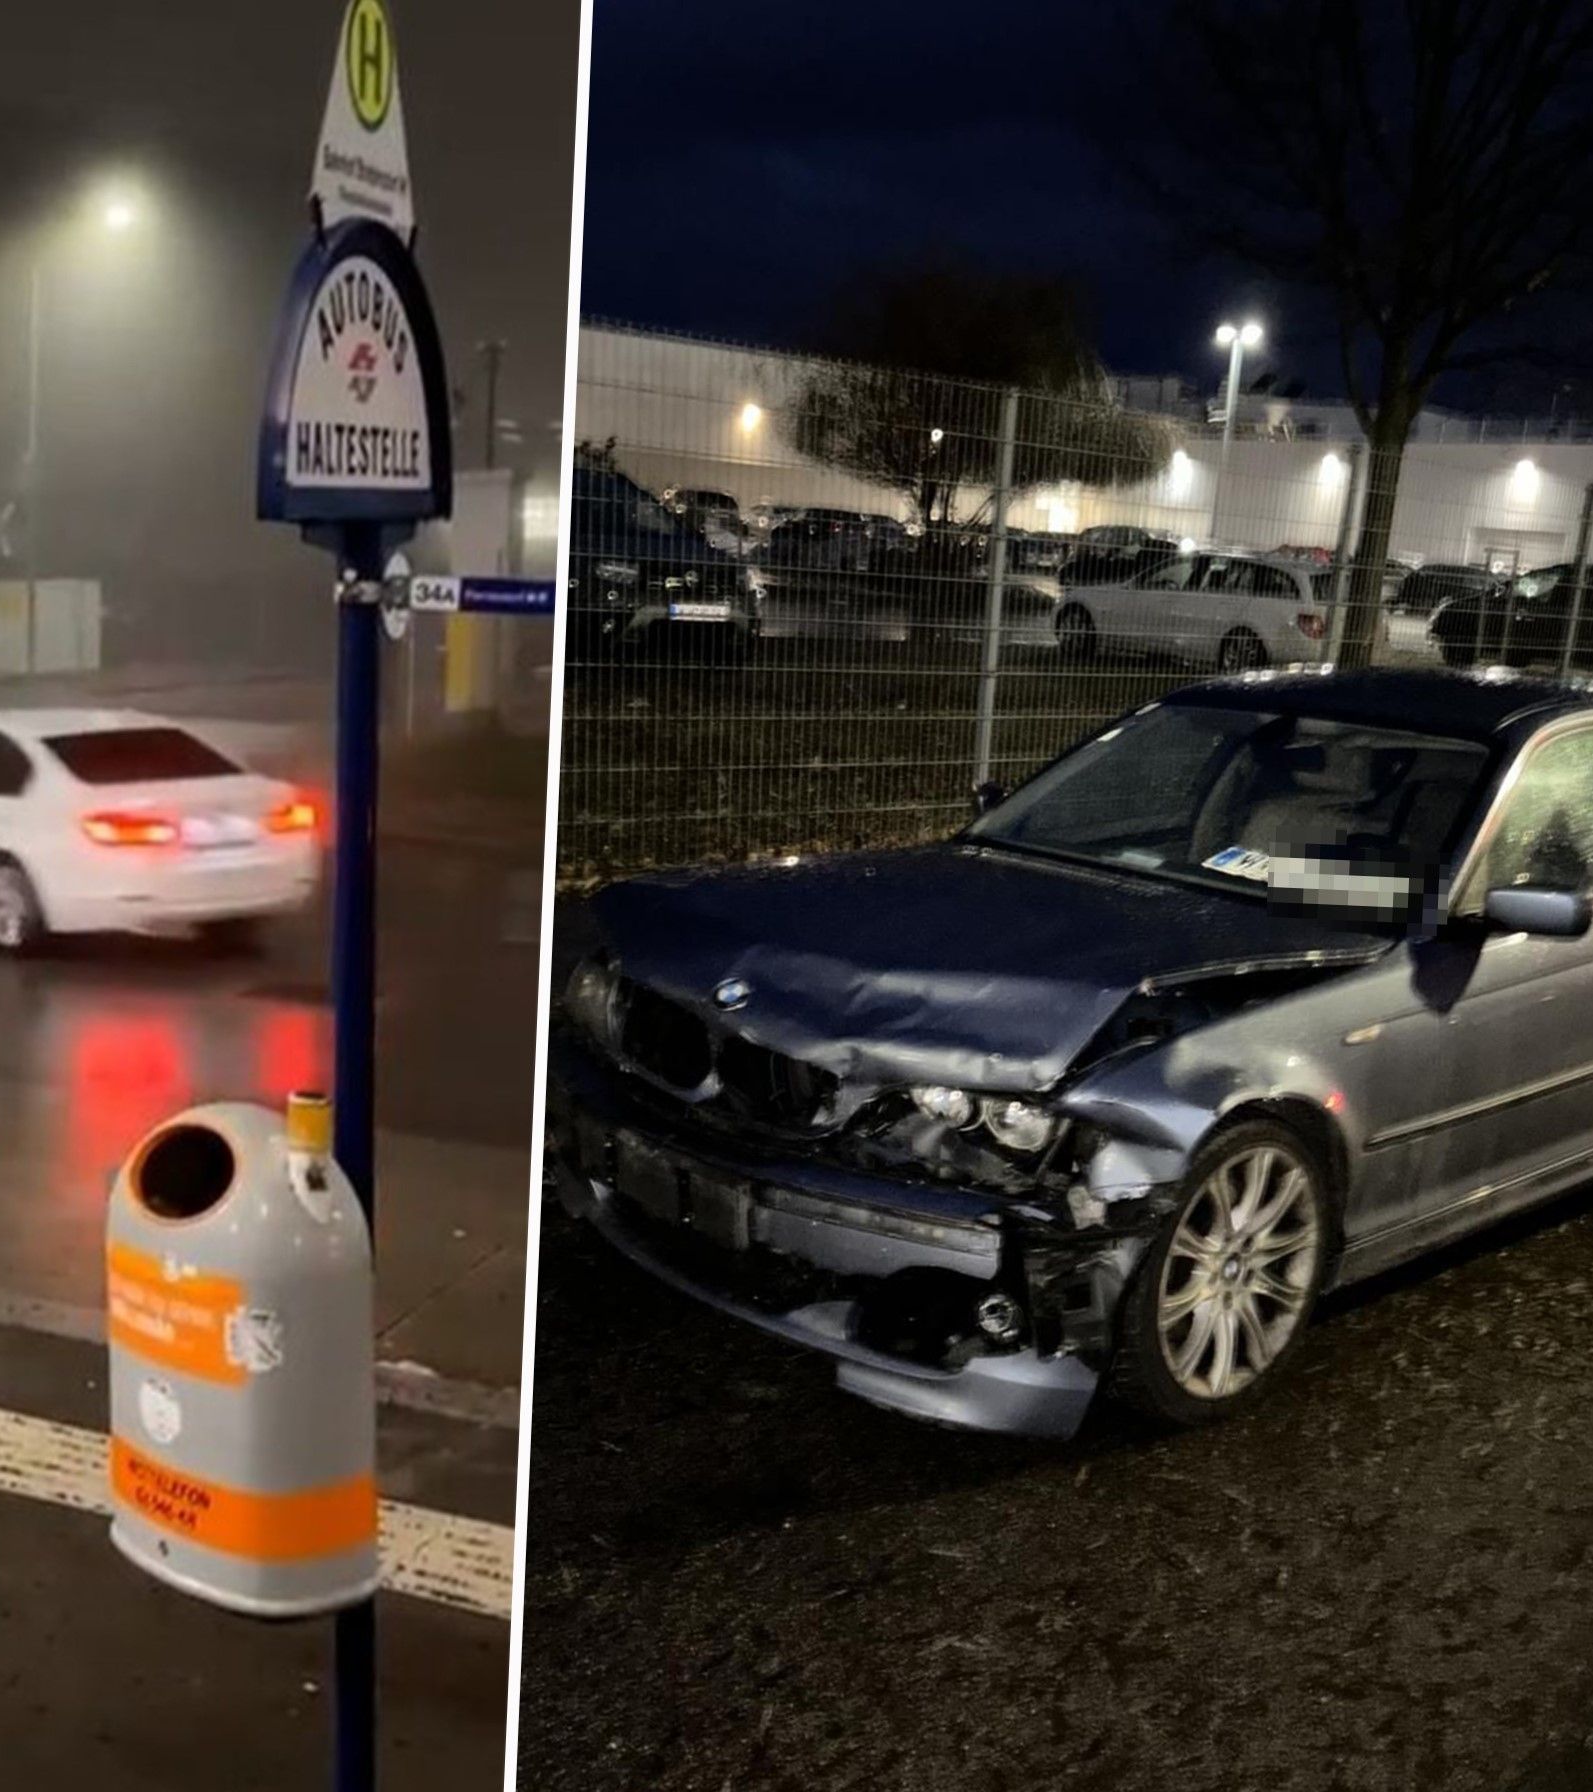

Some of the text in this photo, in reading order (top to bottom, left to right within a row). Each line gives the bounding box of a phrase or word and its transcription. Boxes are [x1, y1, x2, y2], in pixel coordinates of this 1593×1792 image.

[359, 11, 383, 106] H
[317, 270, 409, 376] AUTOBUS
[297, 420, 420, 478] HALTESTELLE
